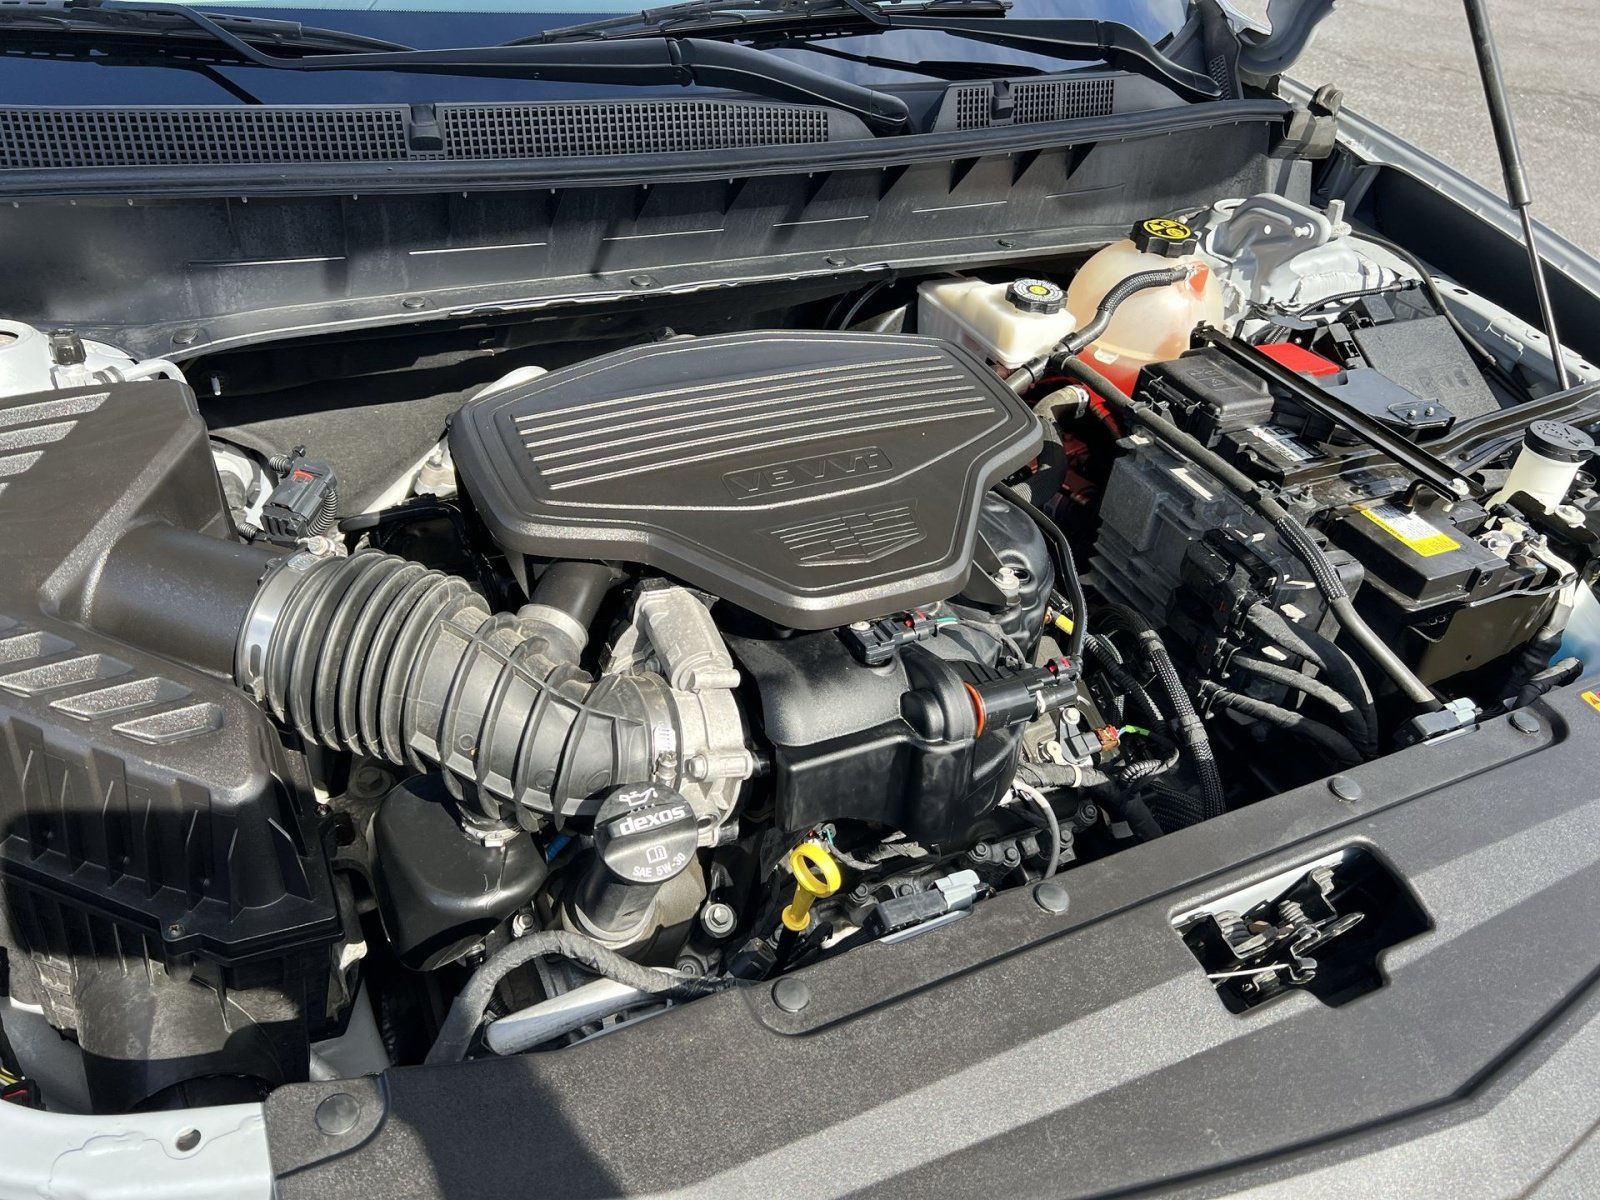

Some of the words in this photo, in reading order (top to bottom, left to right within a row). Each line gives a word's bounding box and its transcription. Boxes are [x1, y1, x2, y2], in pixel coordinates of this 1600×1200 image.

[728, 469, 796, 492] V6
[619, 805, 687, 836] dexos
[632, 865, 653, 878] SAE
[656, 852, 687, 876] 5W-30
